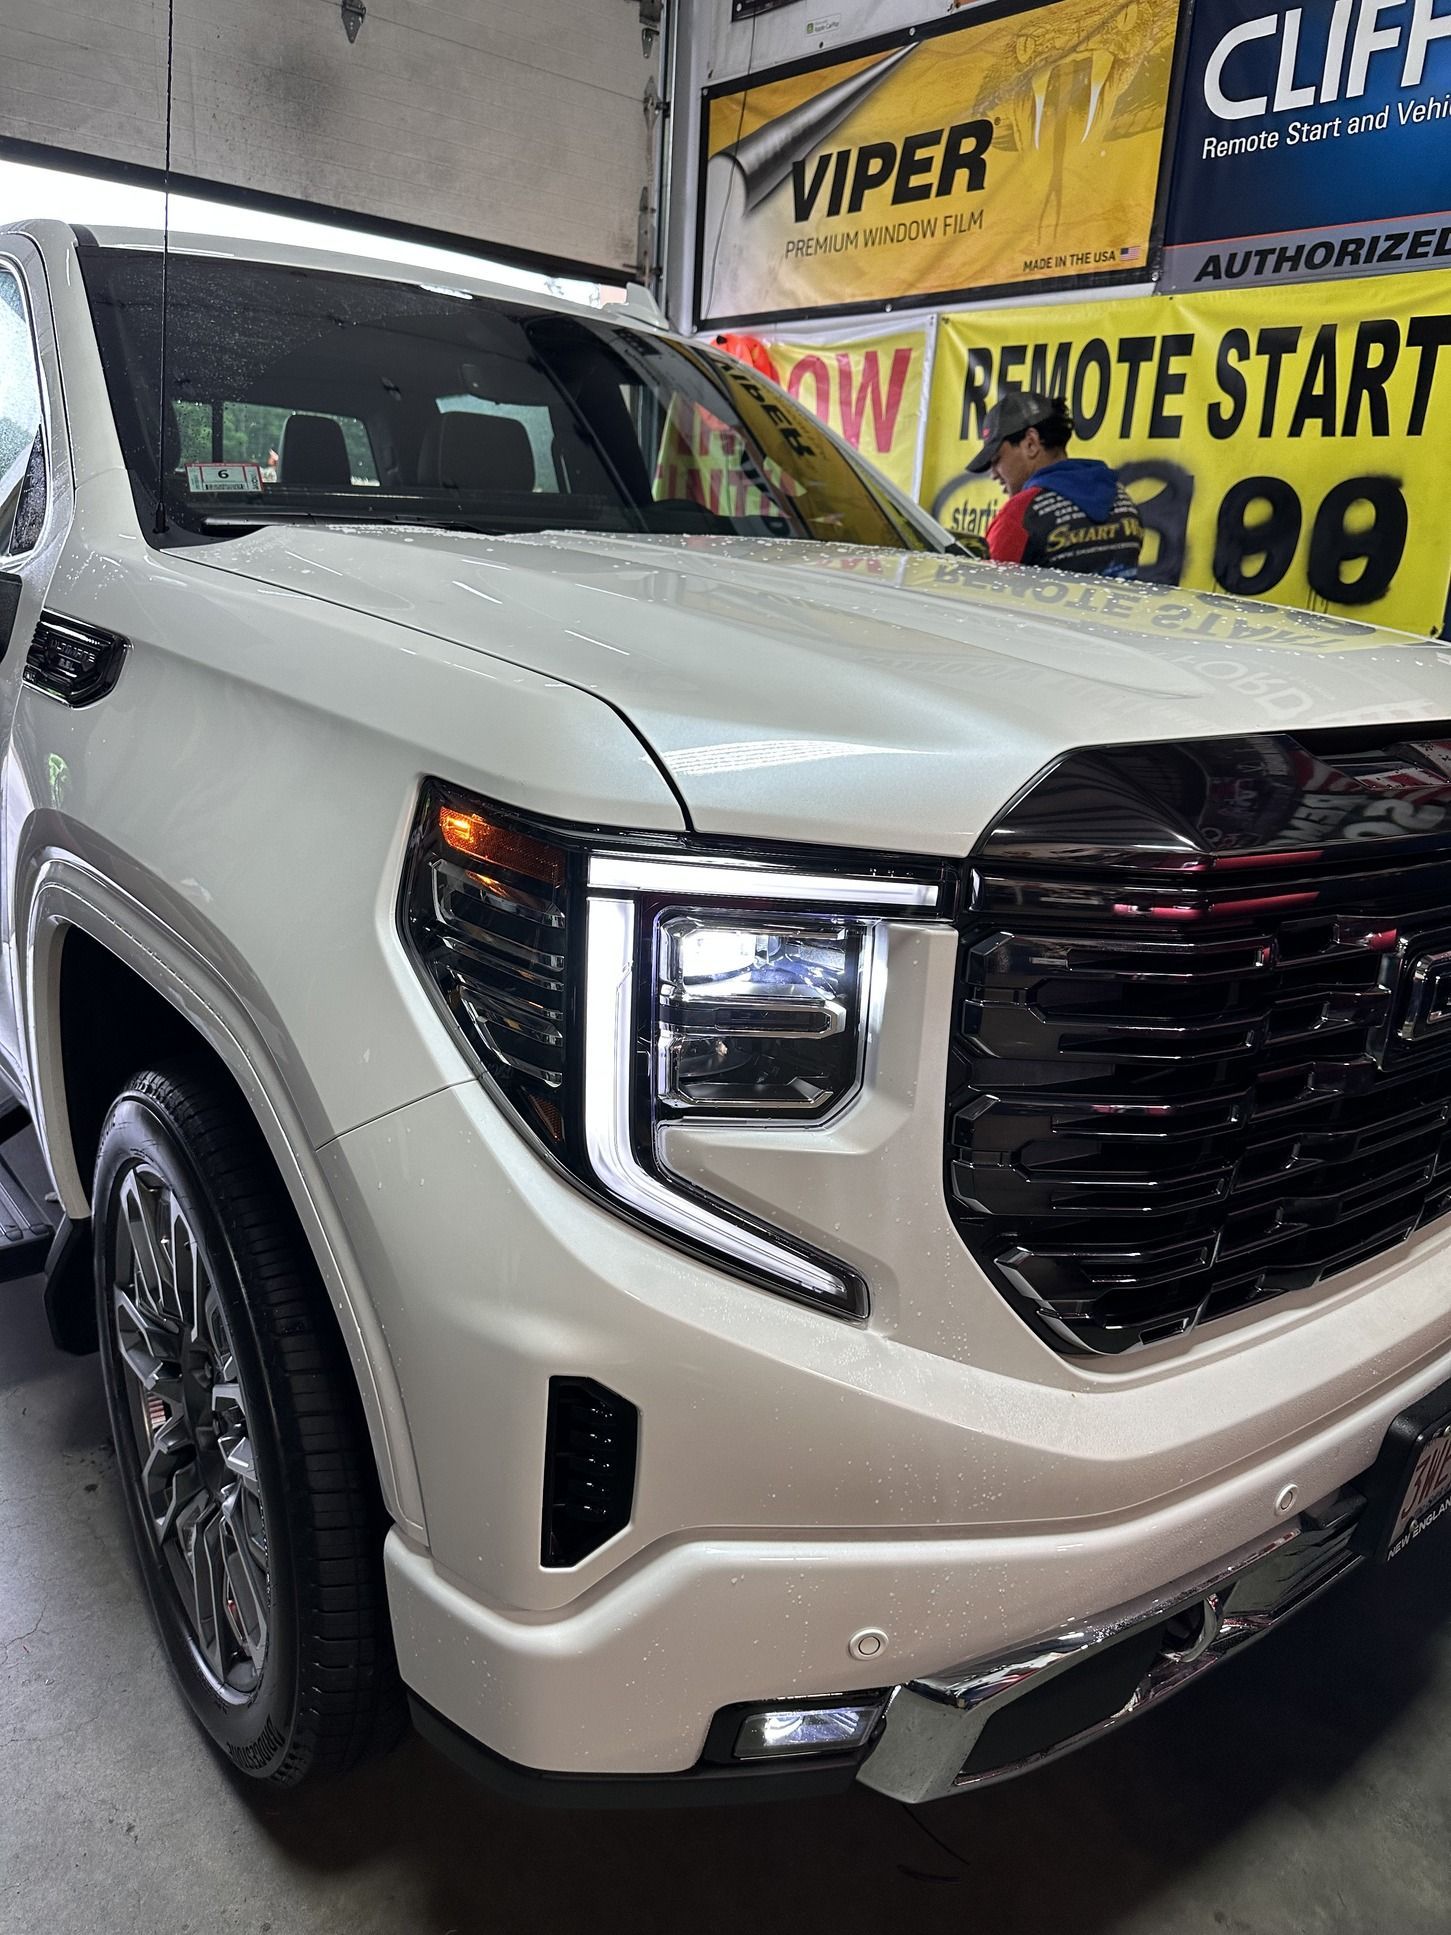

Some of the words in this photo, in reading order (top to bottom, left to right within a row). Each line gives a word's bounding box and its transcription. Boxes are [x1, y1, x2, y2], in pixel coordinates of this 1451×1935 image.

[1202, 131, 1279, 160] Remote
[1286, 117, 1342, 146] Start
[1347, 105, 1390, 135] and
[1397, 94, 1451, 125] Vehi
[792, 119, 994, 223] VIPER
[785, 231, 858, 260] PREMIUM
[863, 217, 937, 249] WINDOW
[943, 209, 984, 236] FILM
[1023, 257, 1053, 273] MADE
[1055, 255, 1067, 268] IN
[1070, 252, 1092, 266] THE
[1094, 250, 1116, 263] USA
[770, 348, 913, 454] OW
[1207, 315, 1451, 440] START
[217, 469, 230, 479] 6
[1047, 523, 1119, 552] SMART
[1387, 1532, 1411, 1562] NEW
